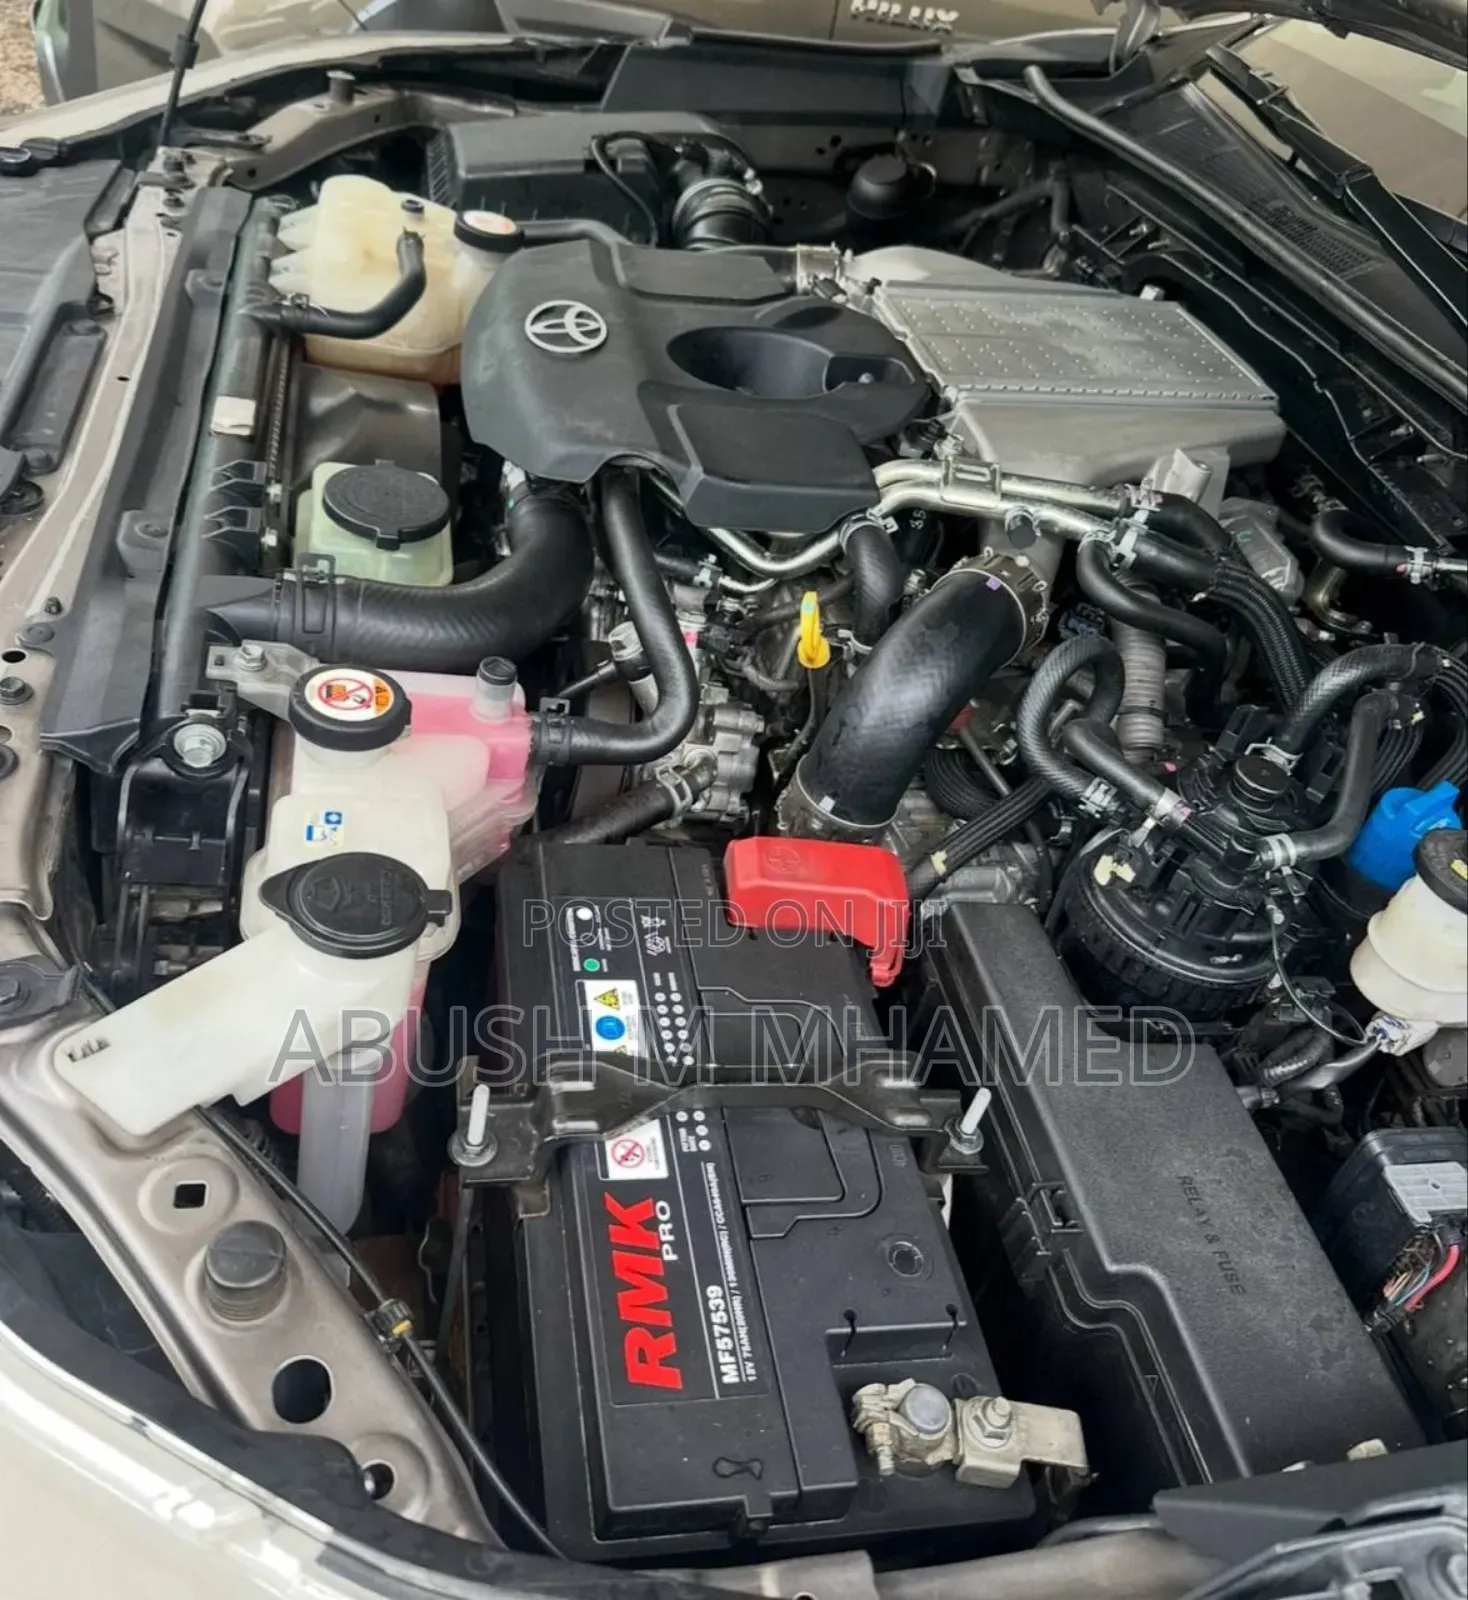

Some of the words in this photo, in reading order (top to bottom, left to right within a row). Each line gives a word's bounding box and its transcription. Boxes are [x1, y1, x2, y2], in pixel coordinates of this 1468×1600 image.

[654, 1200, 679, 1262] PRO
[1176, 1175, 1215, 1228] RELAY
[1203, 1233, 1221, 1244] &
[1212, 1250, 1247, 1295] FUSE
[604, 1192, 683, 1390] RMK
[705, 1284, 741, 1385] MF57539
